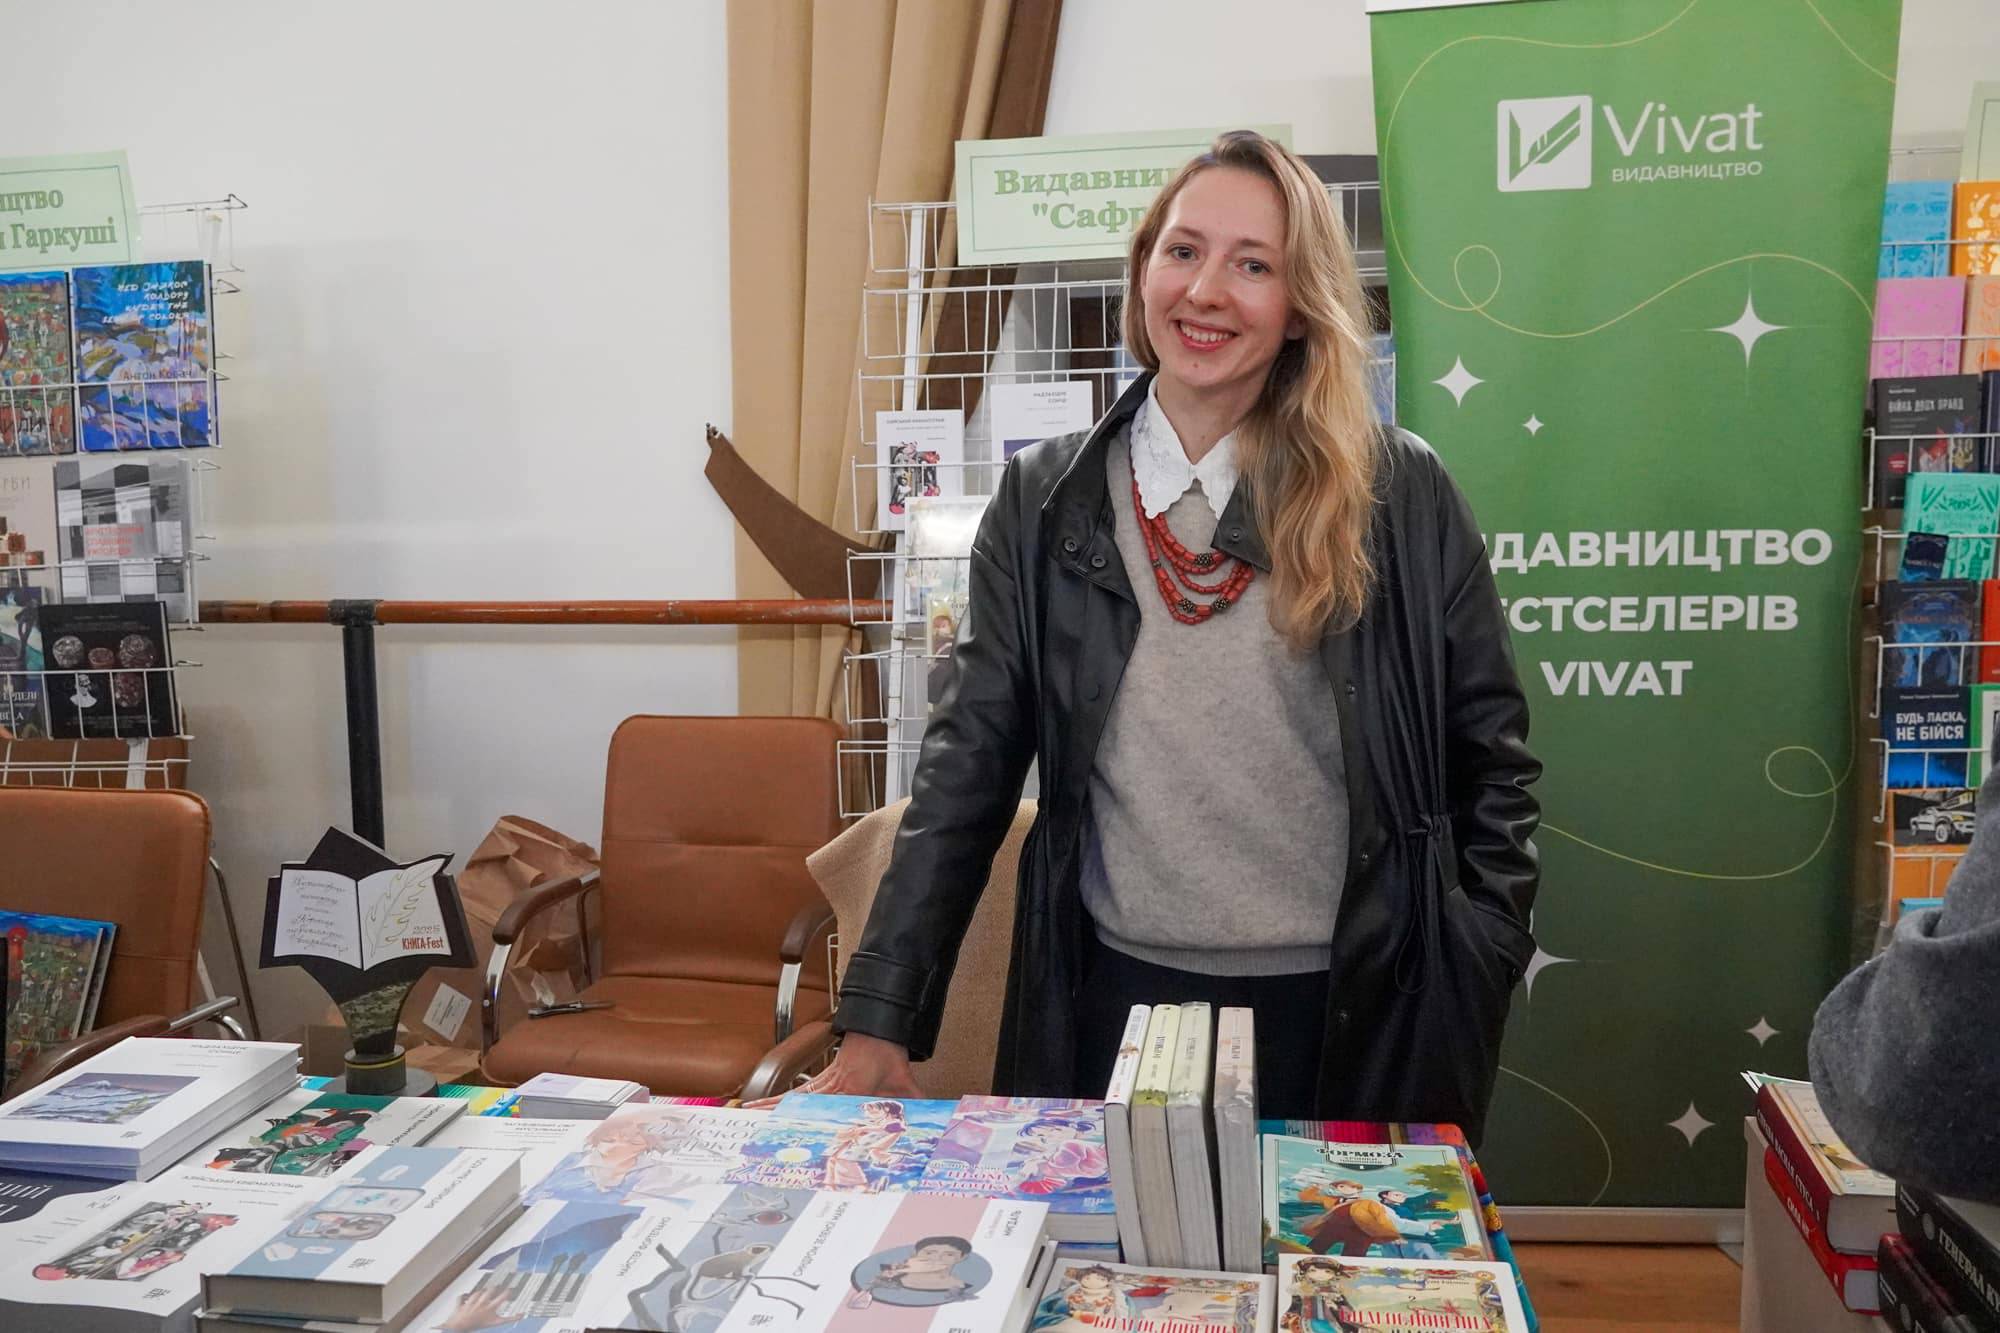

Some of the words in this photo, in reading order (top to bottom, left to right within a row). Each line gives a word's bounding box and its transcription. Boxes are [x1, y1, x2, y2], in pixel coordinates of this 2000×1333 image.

[1602, 101, 1764, 157] Vivat
[1612, 161, 1763, 183] ВИДАВНИЦТВО
[10, 216, 118, 253] Гаркуші
[1539, 660, 1693, 697] VIVAT
[1896, 712, 1925, 725] БУДЬ
[1927, 711, 1967, 724] ЛАСКА,
[1896, 726, 1916, 741] НЕ
[1920, 723, 1965, 741] БІЙСЯ
[1939, 1227, 1985, 1297] ГЕНЕРАЛ
